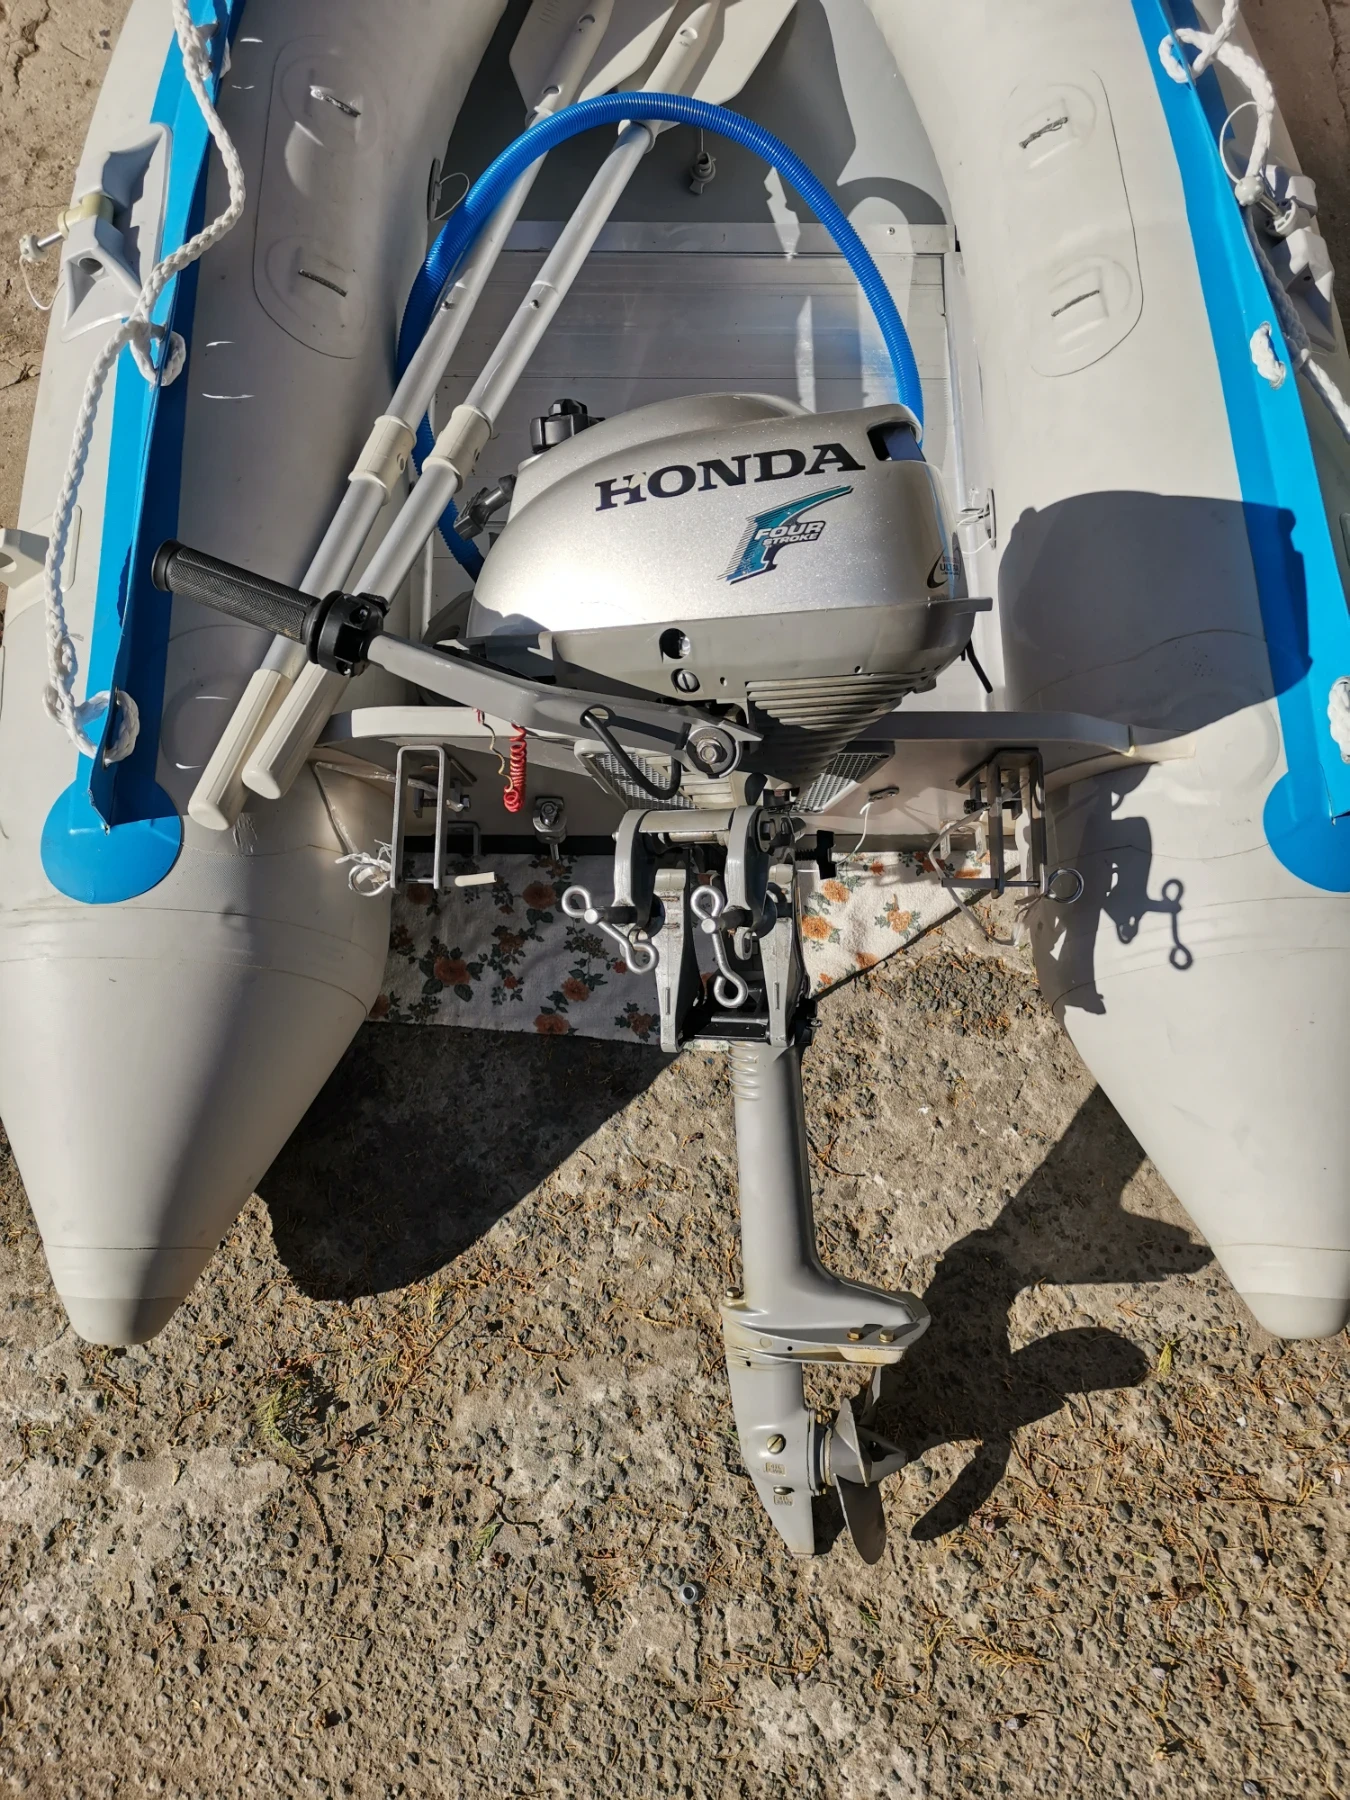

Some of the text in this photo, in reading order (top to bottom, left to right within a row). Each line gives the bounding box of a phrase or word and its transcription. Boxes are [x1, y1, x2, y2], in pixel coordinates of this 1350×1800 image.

[595, 442, 866, 512] HONDA
[754, 521, 825, 541] FOUR
[763, 532, 819, 547] STROKE
